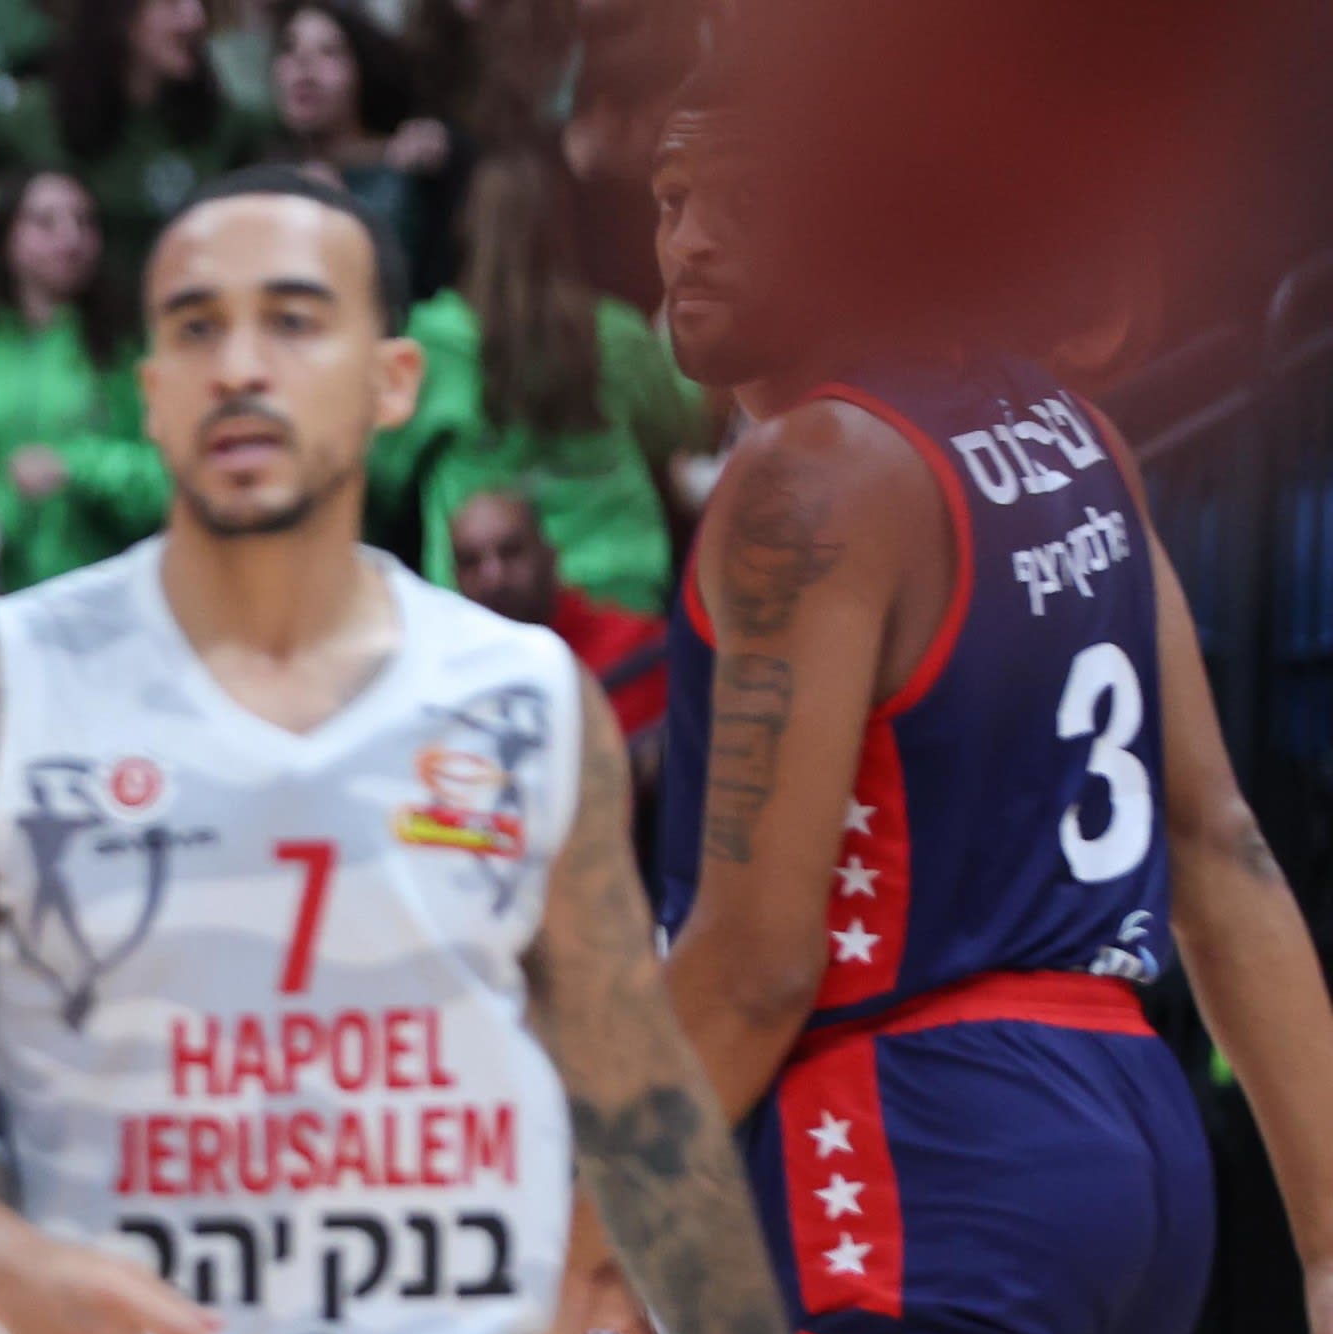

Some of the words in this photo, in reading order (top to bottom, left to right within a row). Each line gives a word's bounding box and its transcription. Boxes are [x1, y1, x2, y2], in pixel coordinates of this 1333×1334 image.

[1056, 641, 1154, 883] 3
[272, 838, 339, 995] 7
[169, 1006, 458, 1097] HAPOEL
[114, 1101, 520, 1196] JERUSALEM
[322, 1209, 520, 1323] בנק
